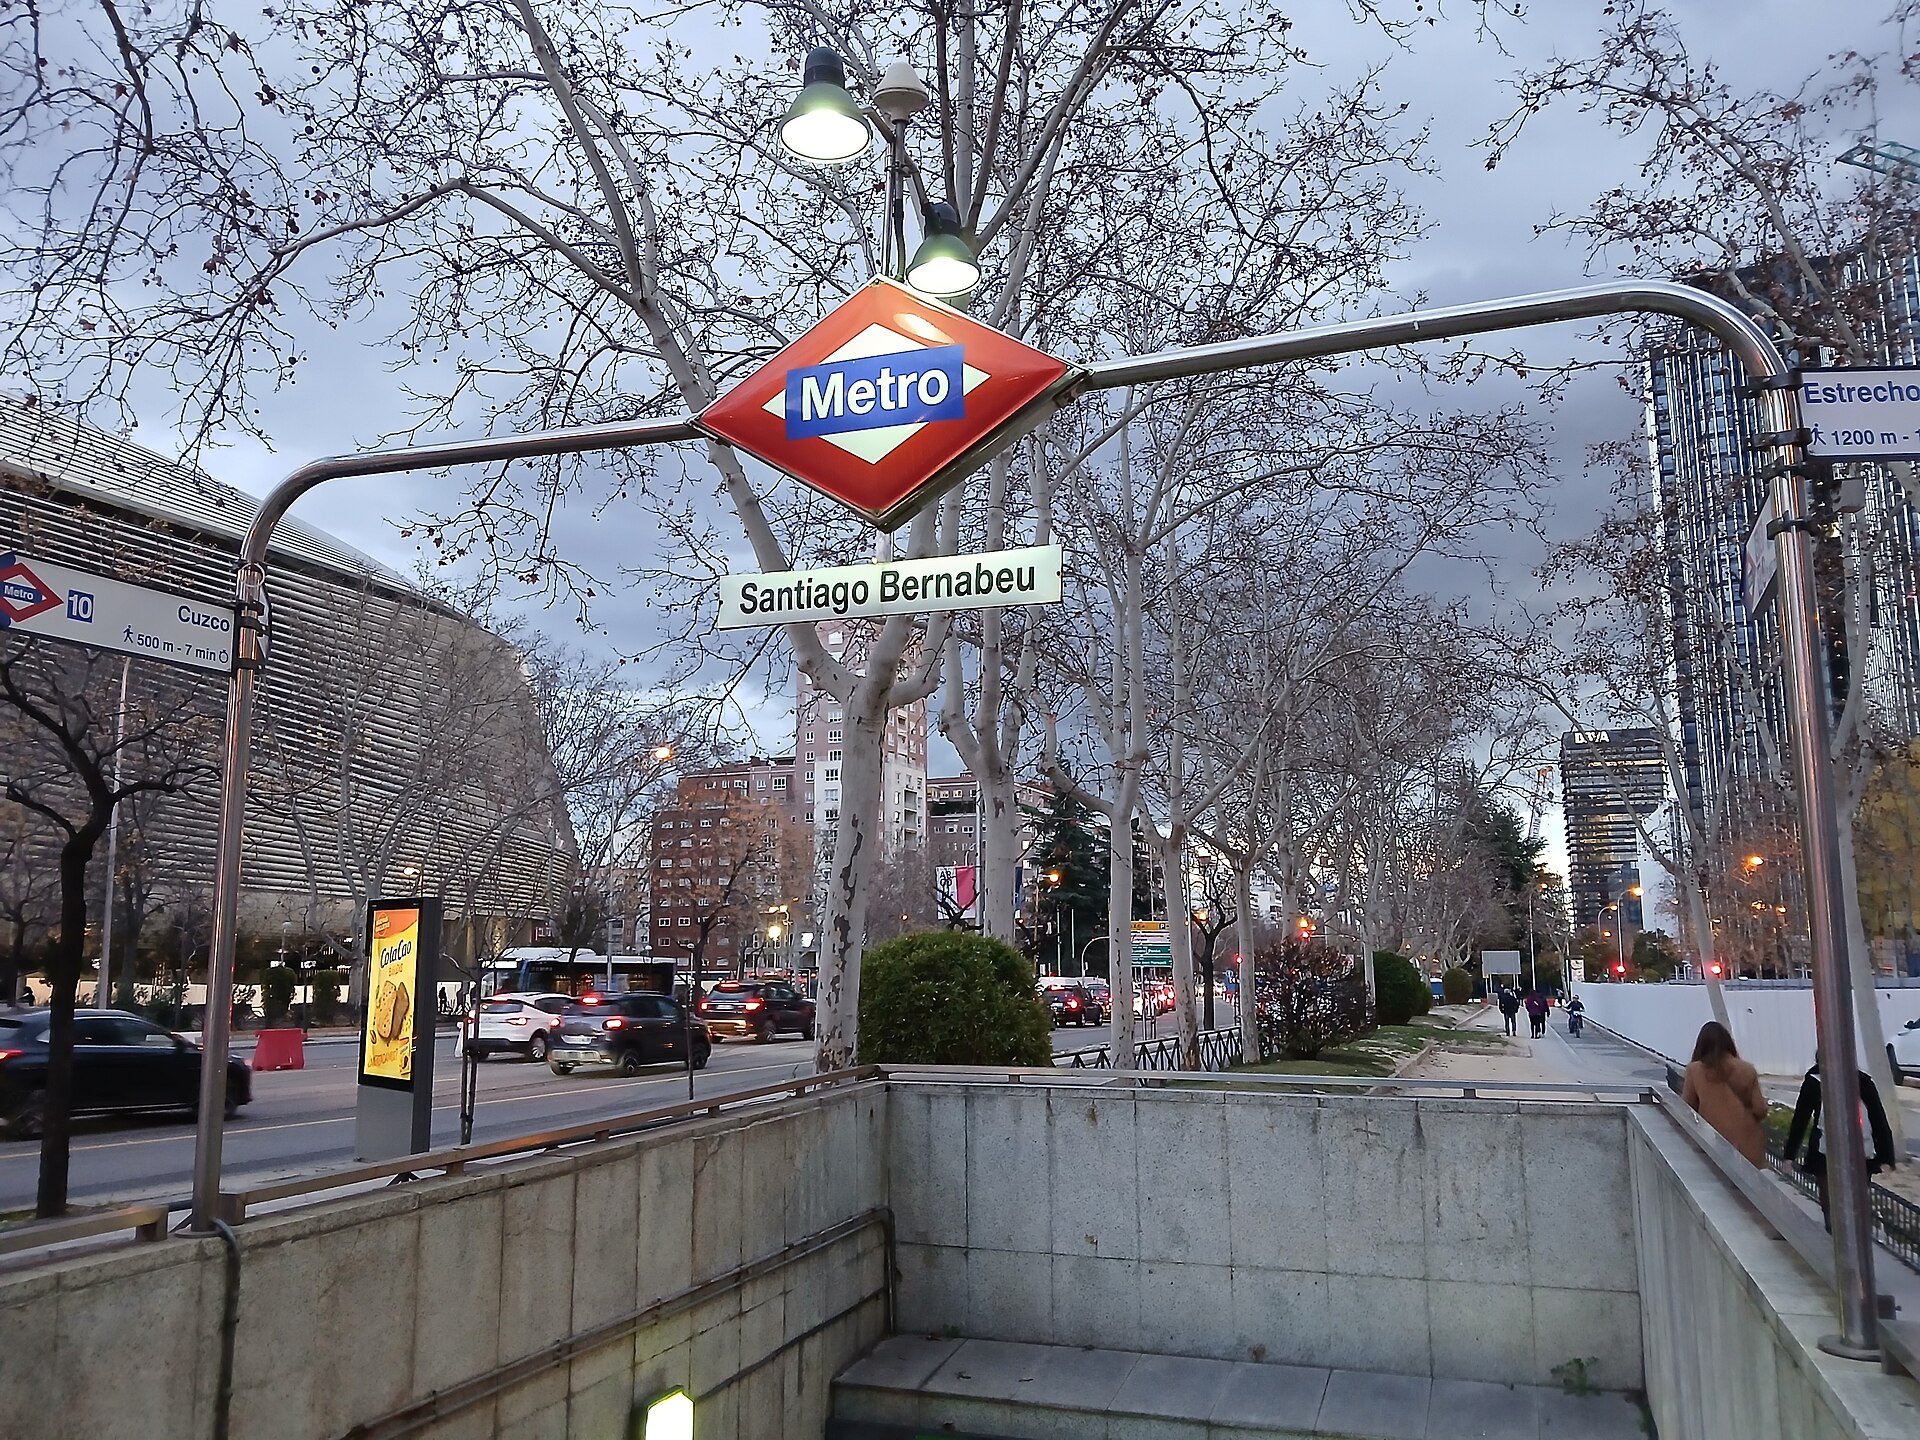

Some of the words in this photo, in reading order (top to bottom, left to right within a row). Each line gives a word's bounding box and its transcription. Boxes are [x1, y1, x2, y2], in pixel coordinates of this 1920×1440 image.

[801, 367, 949, 422] Metro
[1804, 381, 1920, 403] Estrecho
[1831, 430, 1874, 446] 1200
[1880, 432, 1897, 444] m
[4, 585, 34, 600] Metro
[740, 578, 869, 615] Santiago
[880, 563, 1036, 603] Bernabeu
[69, 594, 93, 619] 10
[178, 605, 230, 632] Cuzco
[137, 633, 159, 649] 500
[163, 641, 174, 653] m
[185, 643, 192, 656] 7
[195, 646, 216, 662] min
[381, 939, 412, 968] ColaCao
